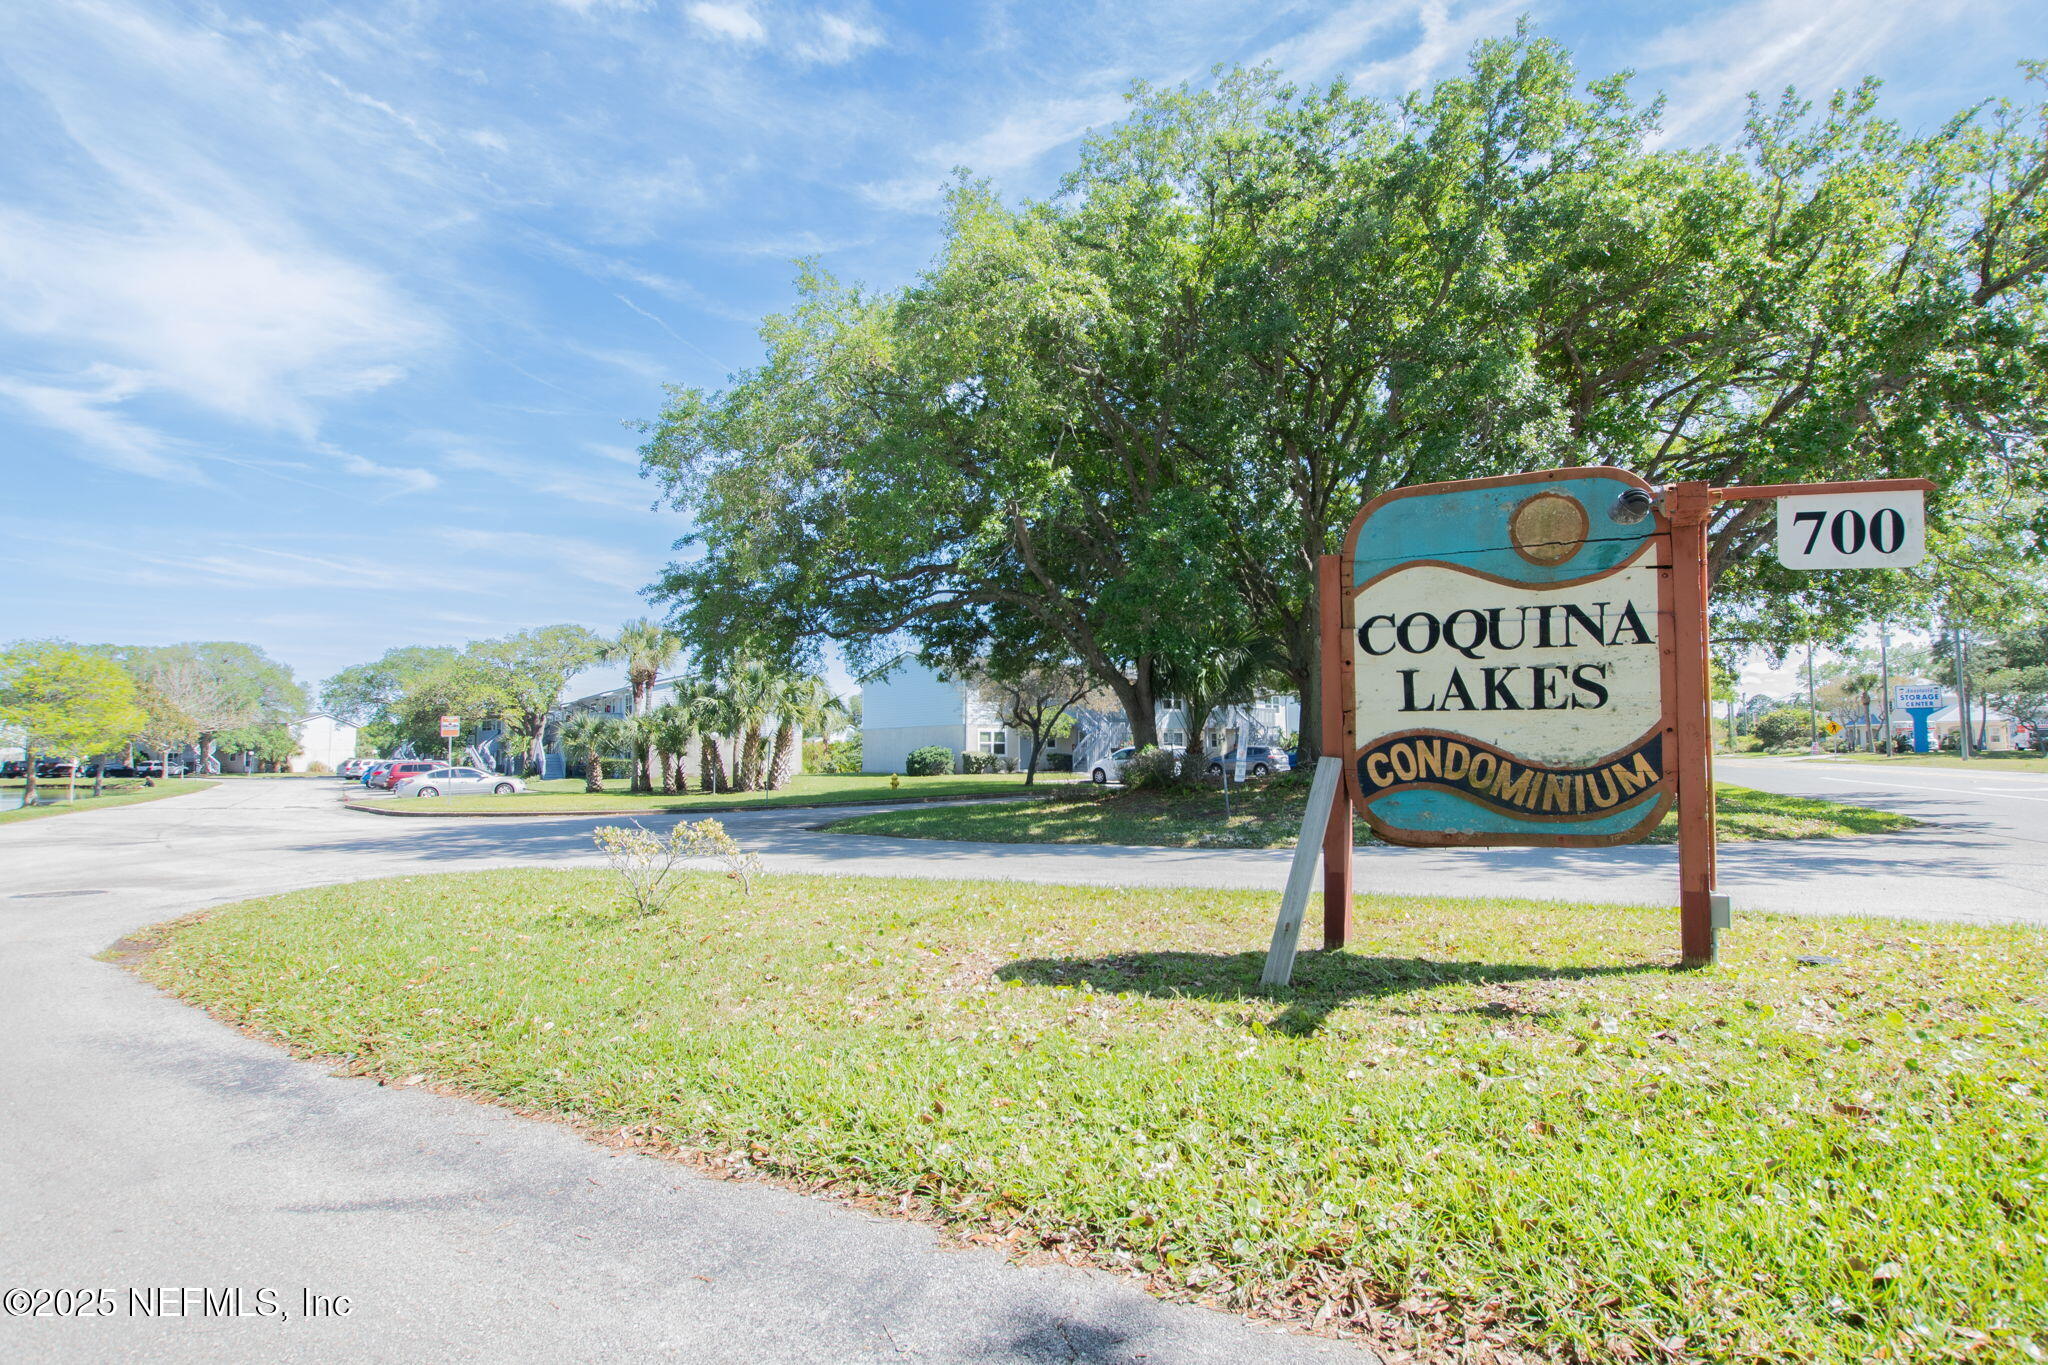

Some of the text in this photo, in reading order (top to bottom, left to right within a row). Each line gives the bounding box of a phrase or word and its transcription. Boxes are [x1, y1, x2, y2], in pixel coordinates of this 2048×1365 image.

[1793, 508, 1905, 555] 700
[1358, 600, 1656, 659] COQUINA
[1396, 664, 1609, 712] LAKES
[1366, 739, 1660, 812] CONDOMINIUM
